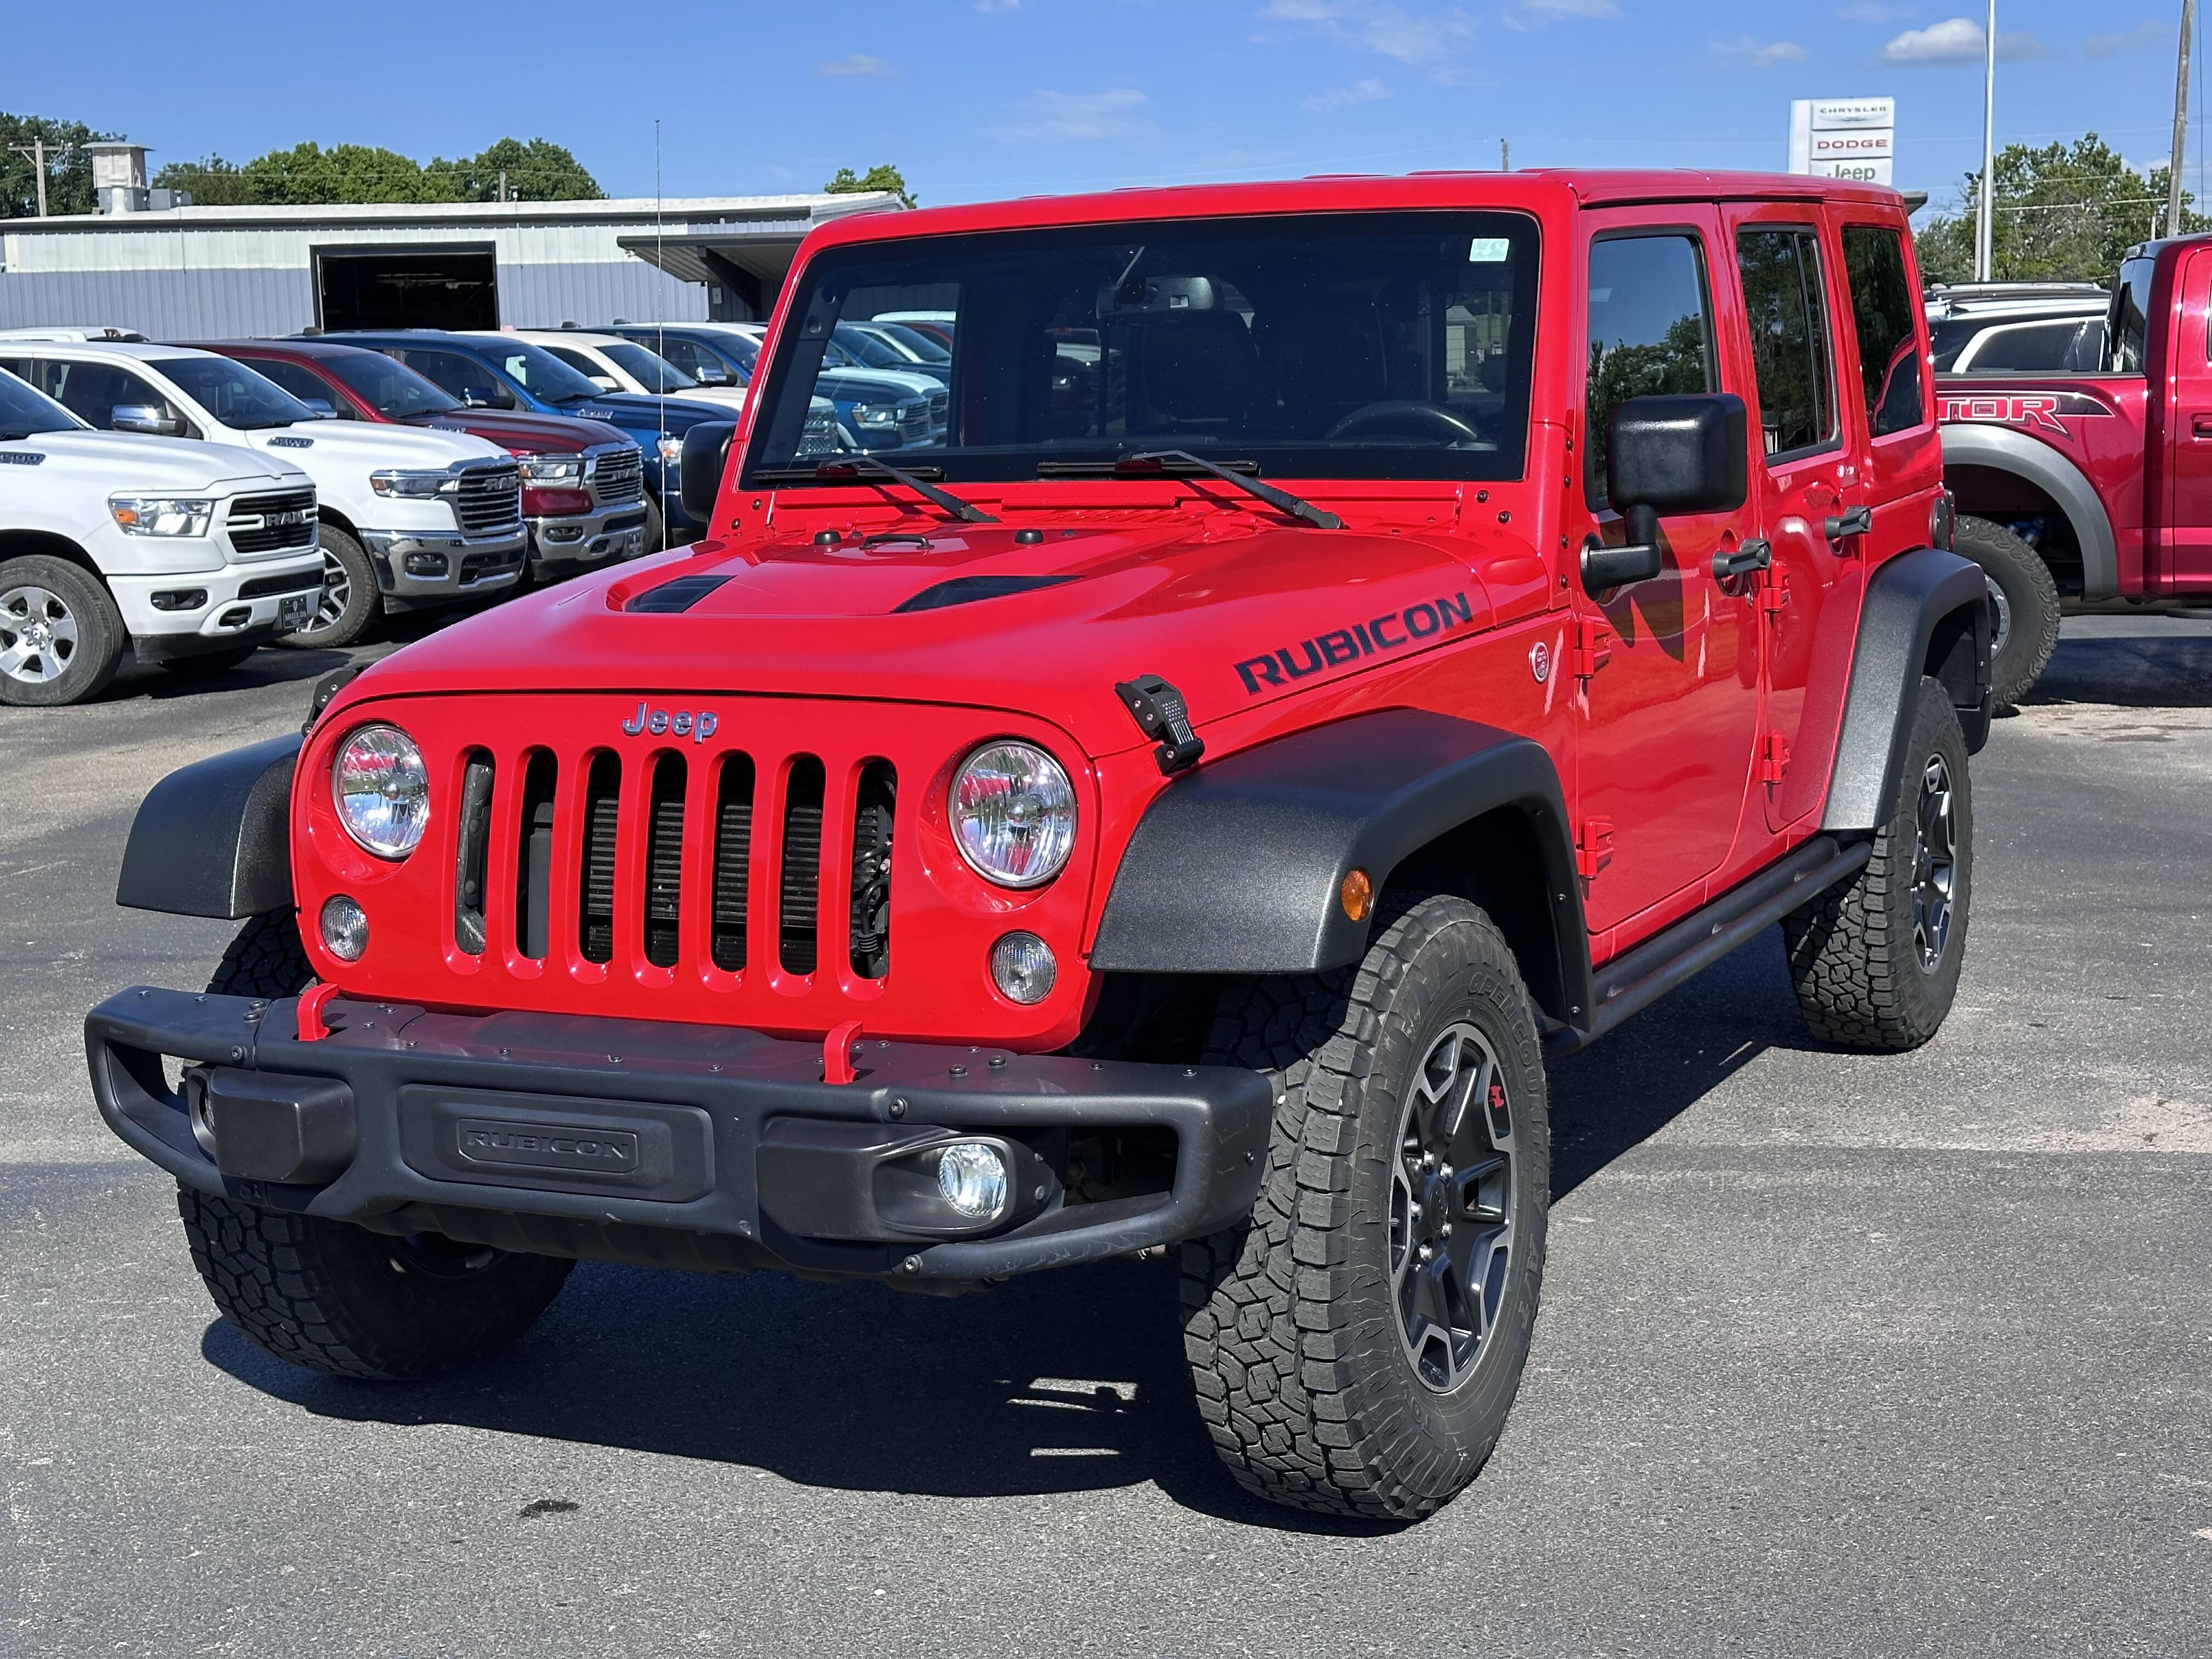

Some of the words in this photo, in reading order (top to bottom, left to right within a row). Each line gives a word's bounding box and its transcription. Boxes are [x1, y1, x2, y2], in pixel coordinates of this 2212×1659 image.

[1820, 106, 1887, 114] CHRYSLER
[1817, 139, 1887, 149] DODGE
[1827, 164, 1876, 182] Jeep
[266, 509, 306, 527] RAM
[1233, 592, 1474, 696] RUBICON
[622, 702, 718, 744] Jeep
[1468, 972, 1519, 1022] OPEN
[466, 1130, 629, 1160] RUBICON
